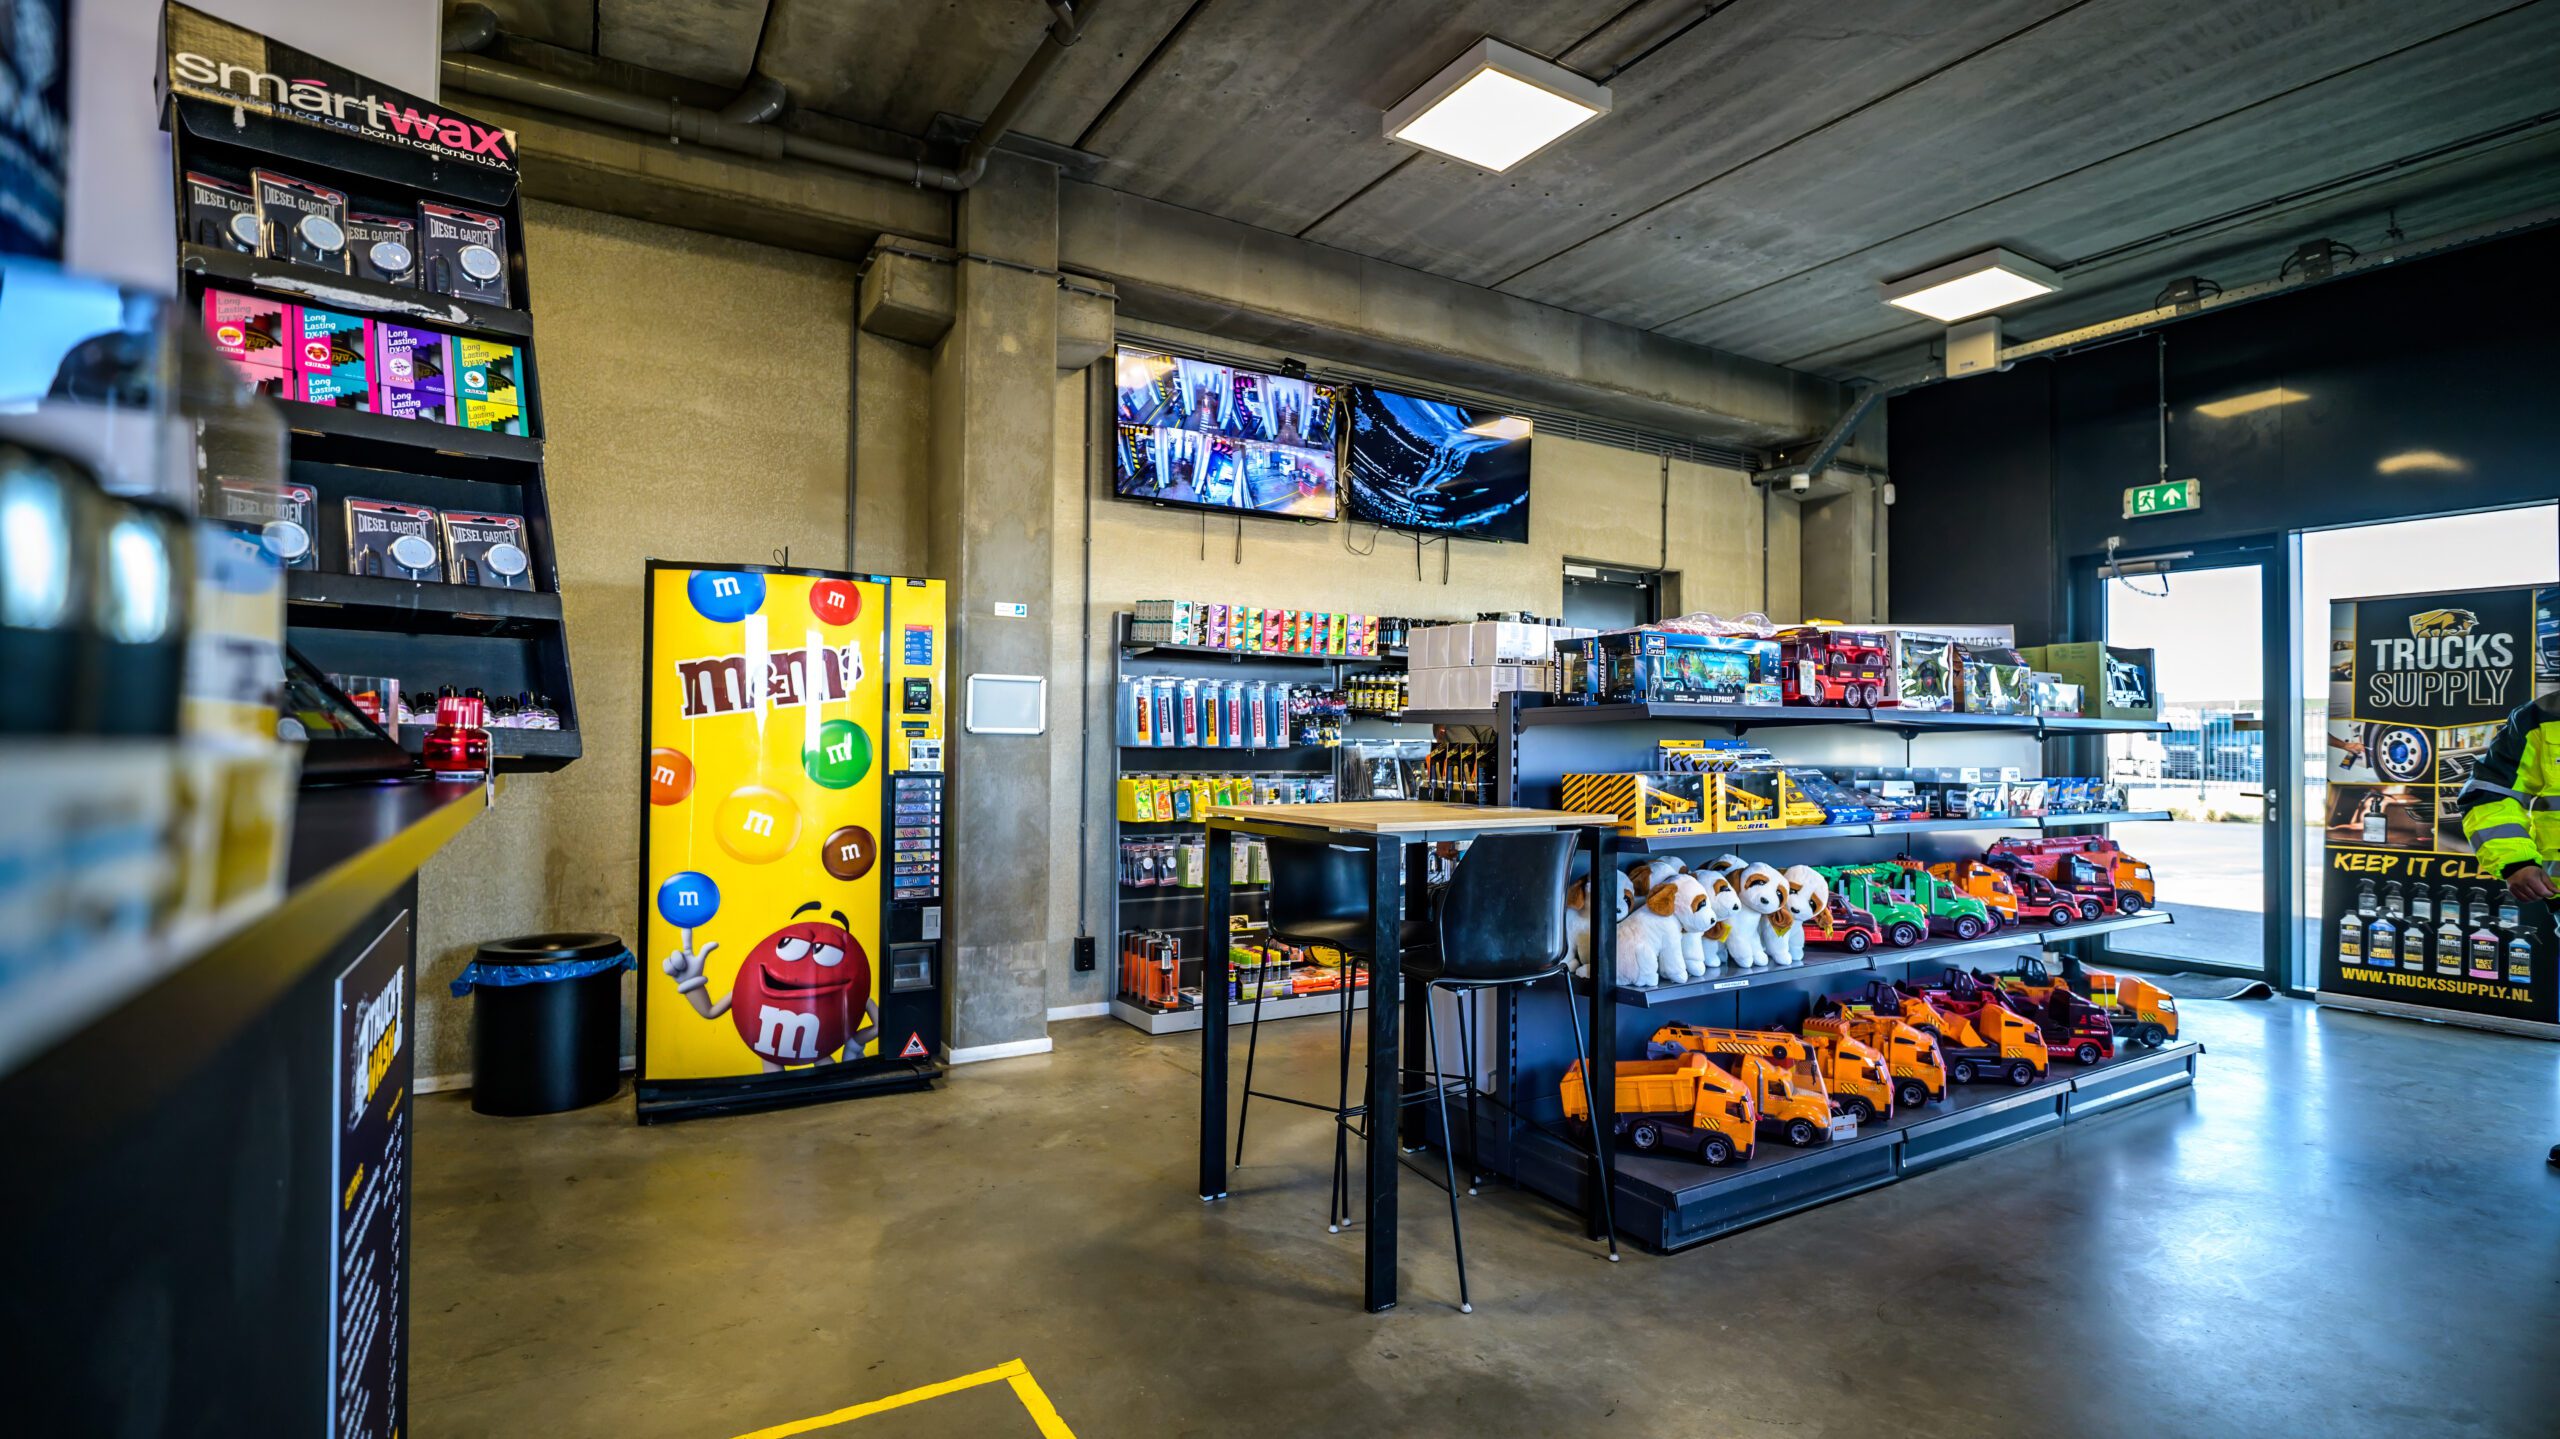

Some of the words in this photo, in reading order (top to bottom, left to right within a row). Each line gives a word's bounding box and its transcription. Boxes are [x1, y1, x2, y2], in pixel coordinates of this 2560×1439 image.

[175, 52, 509, 161] smartwax
[279, 102, 293, 115] in
[296, 110, 322, 122] car
[324, 117, 360, 133] care
[361, 124, 397, 142] born
[398, 134, 411, 146] in
[412, 138, 475, 161] california
[476, 154, 513, 171] U.S.A.
[194, 185, 227, 209] DIESEL
[230, 199, 255, 214] GARD
[264, 184, 297, 209] DIESEL
[298, 198, 336, 222] GARDEN
[349, 227, 370, 241] ESEL
[430, 217, 459, 240] DIESEL
[460, 228, 494, 250] GARDEN
[304, 313, 327, 323] Long
[304, 319, 336, 331] Lasting
[387, 329, 408, 339] Long
[388, 336, 418, 347] Lasting
[462, 343, 481, 352] Long
[463, 350, 490, 359] Lasting
[309, 378, 332, 387] Long
[309, 384, 341, 395] Lasting
[391, 392, 412, 402] Long
[391, 400, 421, 409] Lasting
[467, 404, 486, 413] Long
[357, 513, 389, 533] DIESEL
[390, 520, 427, 539] GARDEN
[452, 525, 483, 544] DIESEL
[482, 530, 517, 546] GARDEN
[712, 575, 741, 598] m
[826, 590, 846, 609] m
[2370, 632, 2514, 672] TRUCKS
[2369, 668, 2513, 708] SUPPLY
[652, 765, 676, 786] m
[742, 809, 774, 837] m
[840, 842, 862, 862] m
[2334, 852, 2399, 875] KEEP
[2406, 857, 2435, 878] IT
[678, 889, 700, 907] m
[2341, 966, 2533, 1003] WWW.TRUCKSSUPPLY.NL
[754, 1003, 821, 1059] m
